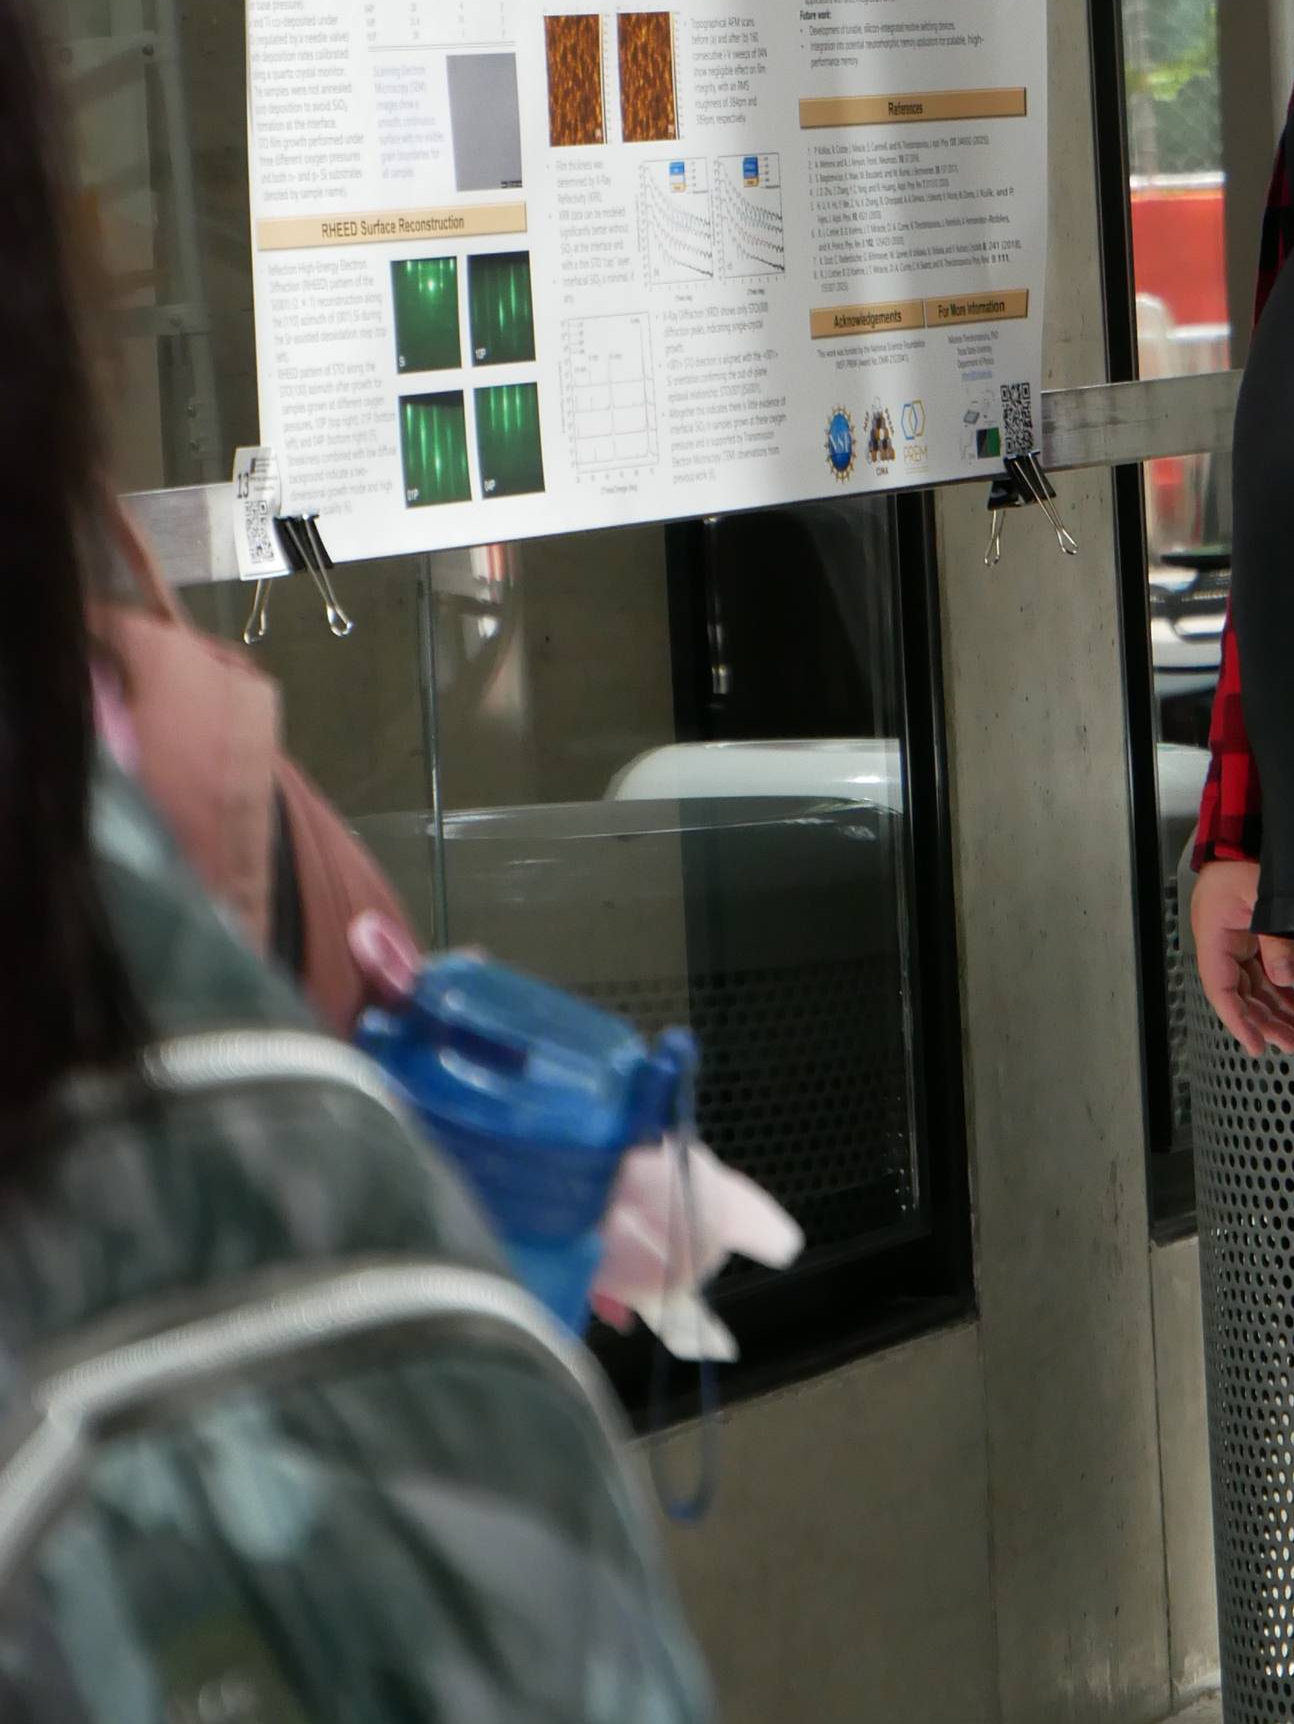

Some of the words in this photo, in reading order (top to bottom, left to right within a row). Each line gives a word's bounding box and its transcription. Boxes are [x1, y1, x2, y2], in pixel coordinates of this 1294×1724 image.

[321, 220, 358, 238] RHEED
[360, 219, 396, 236] Surface
[399, 215, 465, 233] Reconstruction
[833, 310, 903, 328] Acknowledgements
[938, 304, 950, 319] For
[950, 304, 966, 318] More
[967, 301, 1006, 317] Information
[236, 473, 250, 499] 13
